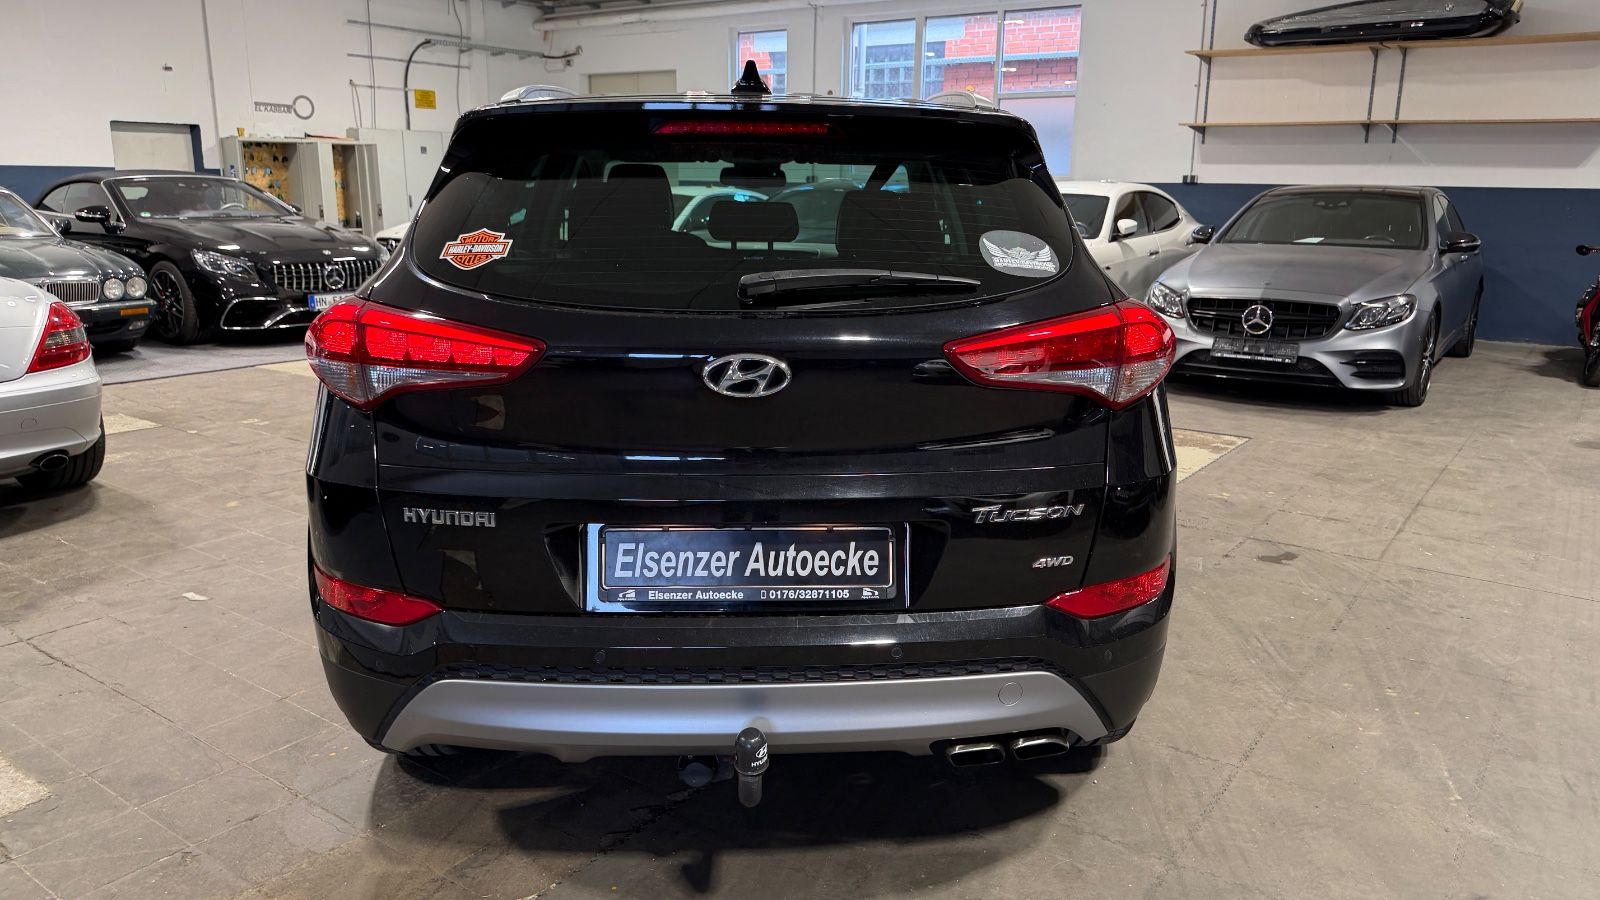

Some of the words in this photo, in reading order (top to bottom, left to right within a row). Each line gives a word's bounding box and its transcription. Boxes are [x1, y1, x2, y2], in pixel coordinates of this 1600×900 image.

[465, 234, 496, 243] MOTOR
[448, 244, 505, 254] HARLEY-DAVIDSON
[456, 255, 487, 266] CYCLES
[403, 507, 496, 528] HYUNDAI
[971, 504, 1085, 524] TUCSON
[614, 542, 741, 578] Elsenzer
[744, 541, 879, 577] Autoecke
[1032, 555, 1074, 569] 4WD
[648, 590, 693, 600] Elsenzer
[695, 590, 744, 600] Autoecke
[769, 589, 850, 599] 0176/32871105
